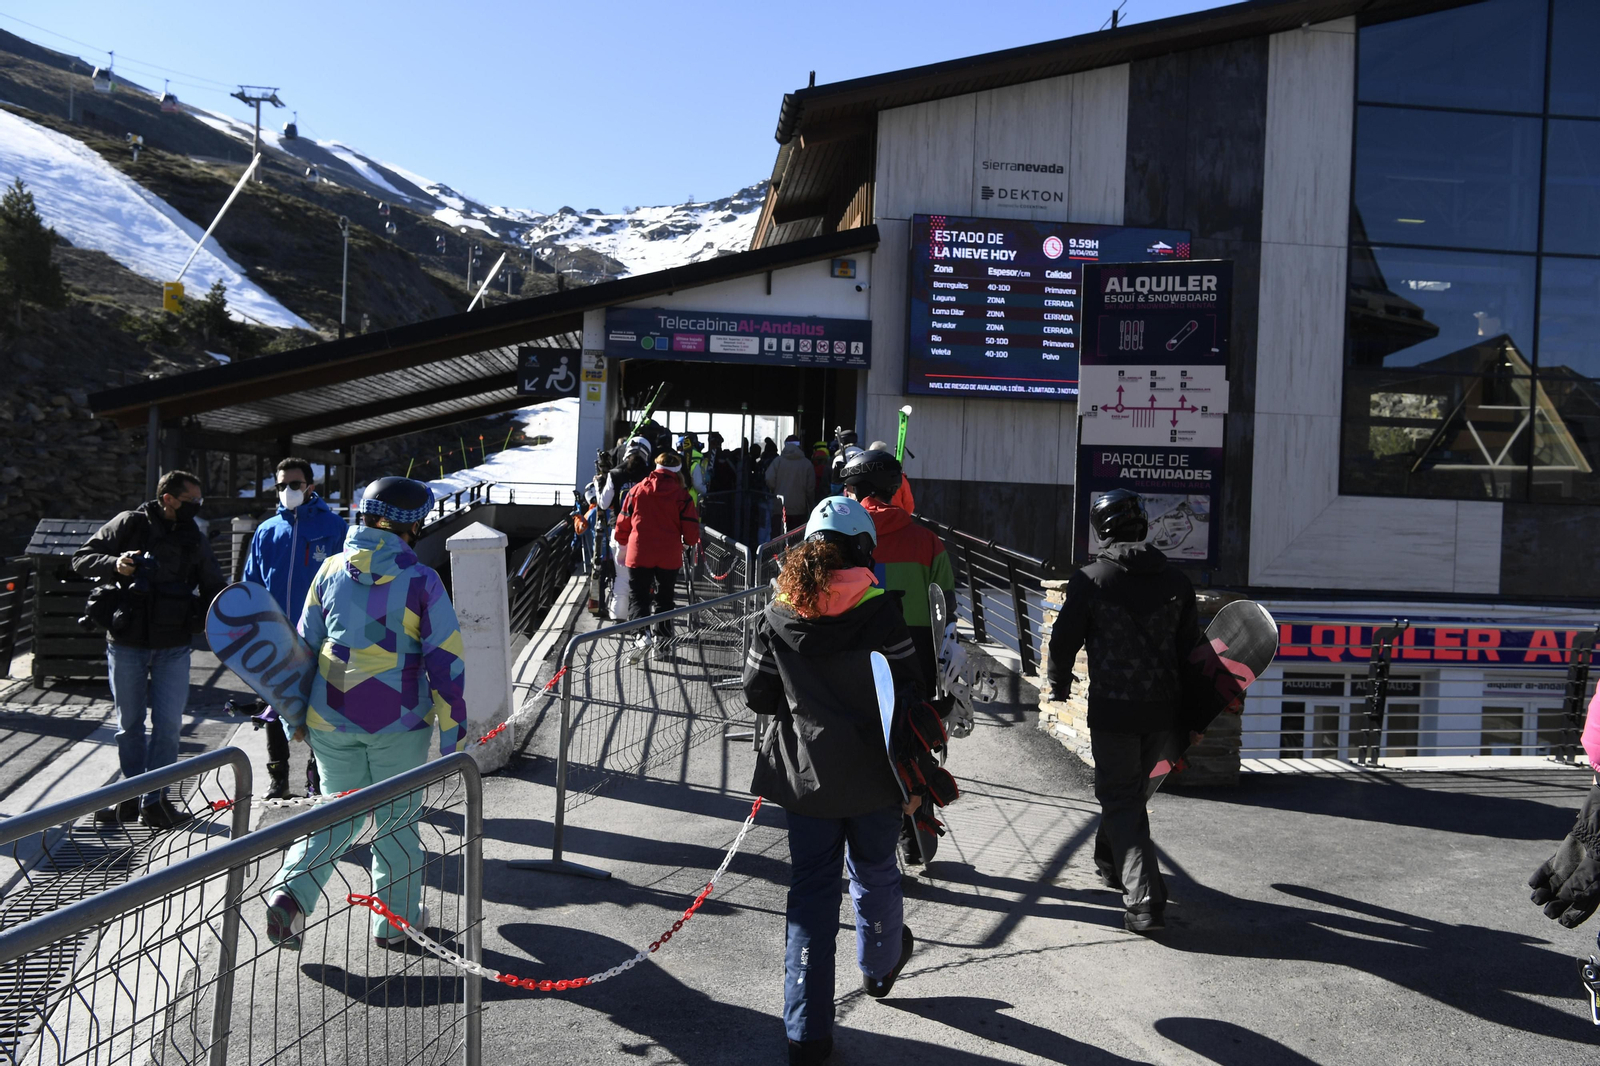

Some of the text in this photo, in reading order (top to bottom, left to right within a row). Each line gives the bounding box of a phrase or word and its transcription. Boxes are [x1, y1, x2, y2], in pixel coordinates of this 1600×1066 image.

[998, 188, 1063, 202] DEKTON
[935, 230, 1004, 245] ESTADO DE
[1069, 238, 1099, 249] 9.59H
[934, 246, 1017, 261] LA NIEVE HOY
[934, 264, 1072, 279] Zona Espesor/cm Calidad
[933, 281, 1077, 295] Borreguiles 40-100 Primavera
[1105, 275, 1217, 295] ALQUILER
[932, 294, 956, 303] Laguna
[1044, 299, 1074, 308] CERRADA
[1104, 292, 1217, 303] ESQUÍ & SNOWBOARD
[932, 308, 949, 316] Loma
[986, 310, 1005, 318] ZONA
[1043, 313, 1074, 321] CERRADA
[931, 321, 1073, 335] Parador ZONA CERRADA
[985, 337, 1009, 345] 50-100
[1042, 340, 1075, 348] Primavera
[931, 348, 1060, 361] Veleta 40-100 Polvo
[1101, 453, 1189, 467] PARQUE DE
[839, 461, 884, 478] QKSLVR
[1119, 468, 1212, 480] ACTIVIDADES
[1188, 481, 1211, 489] AREA
[1285, 680, 1332, 689] ALQUILER
